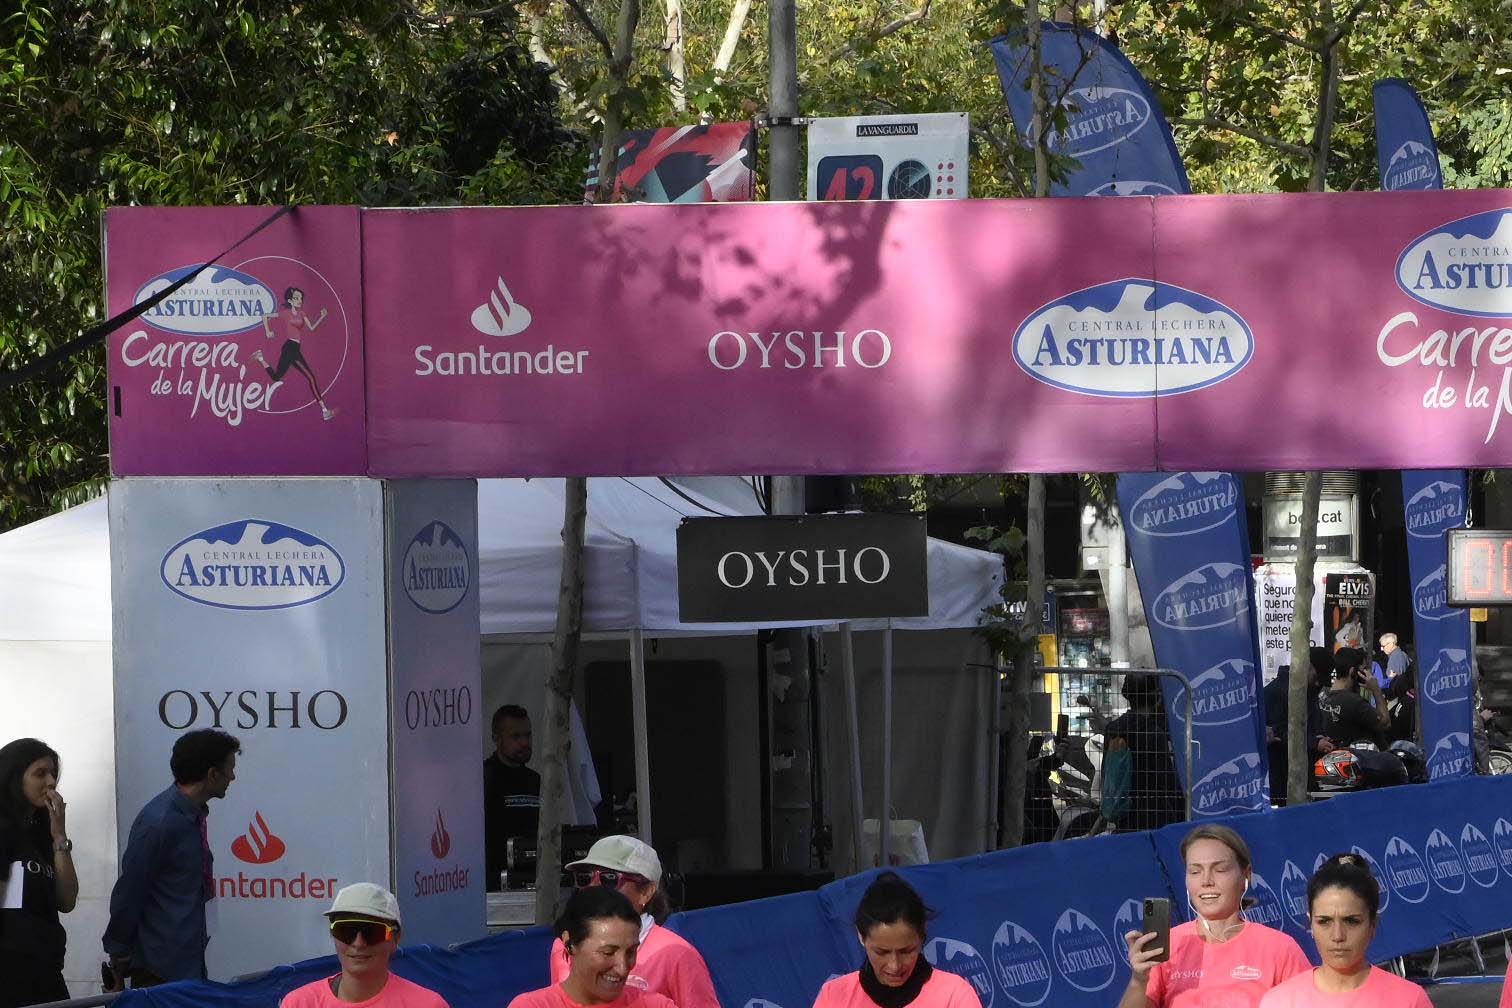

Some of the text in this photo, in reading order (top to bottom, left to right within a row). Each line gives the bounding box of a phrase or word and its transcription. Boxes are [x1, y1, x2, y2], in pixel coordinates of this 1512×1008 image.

[146, 297, 265, 317] ASTURIANA
[1067, 318, 1228, 332] CENTRAL LECHERA
[121, 330, 241, 368] Carrera
[415, 345, 589, 376] Santander
[707, 328, 892, 371] OYSHO
[1031, 321, 1236, 367] ASTURIANA
[150, 365, 284, 426] de la Mujer
[1422, 370, 1457, 409] de
[1464, 370, 1490, 409] la
[175, 553, 332, 587] ASTURIANA
[203, 550, 326, 560] CENTRAL LECHERA
[717, 546, 891, 589] OYSHO
[1265, 599, 1281, 610] que
[1339, 582, 1370, 595] ELVIS
[1266, 639, 1284, 650] este
[158, 689, 348, 731] OYSHO
[406, 684, 472, 731] OYSHO
[414, 864, 470, 899] Santander
[997, 952, 1049, 988] ASTURIANA
[1057, 942, 1113, 976] ASTURIANA
